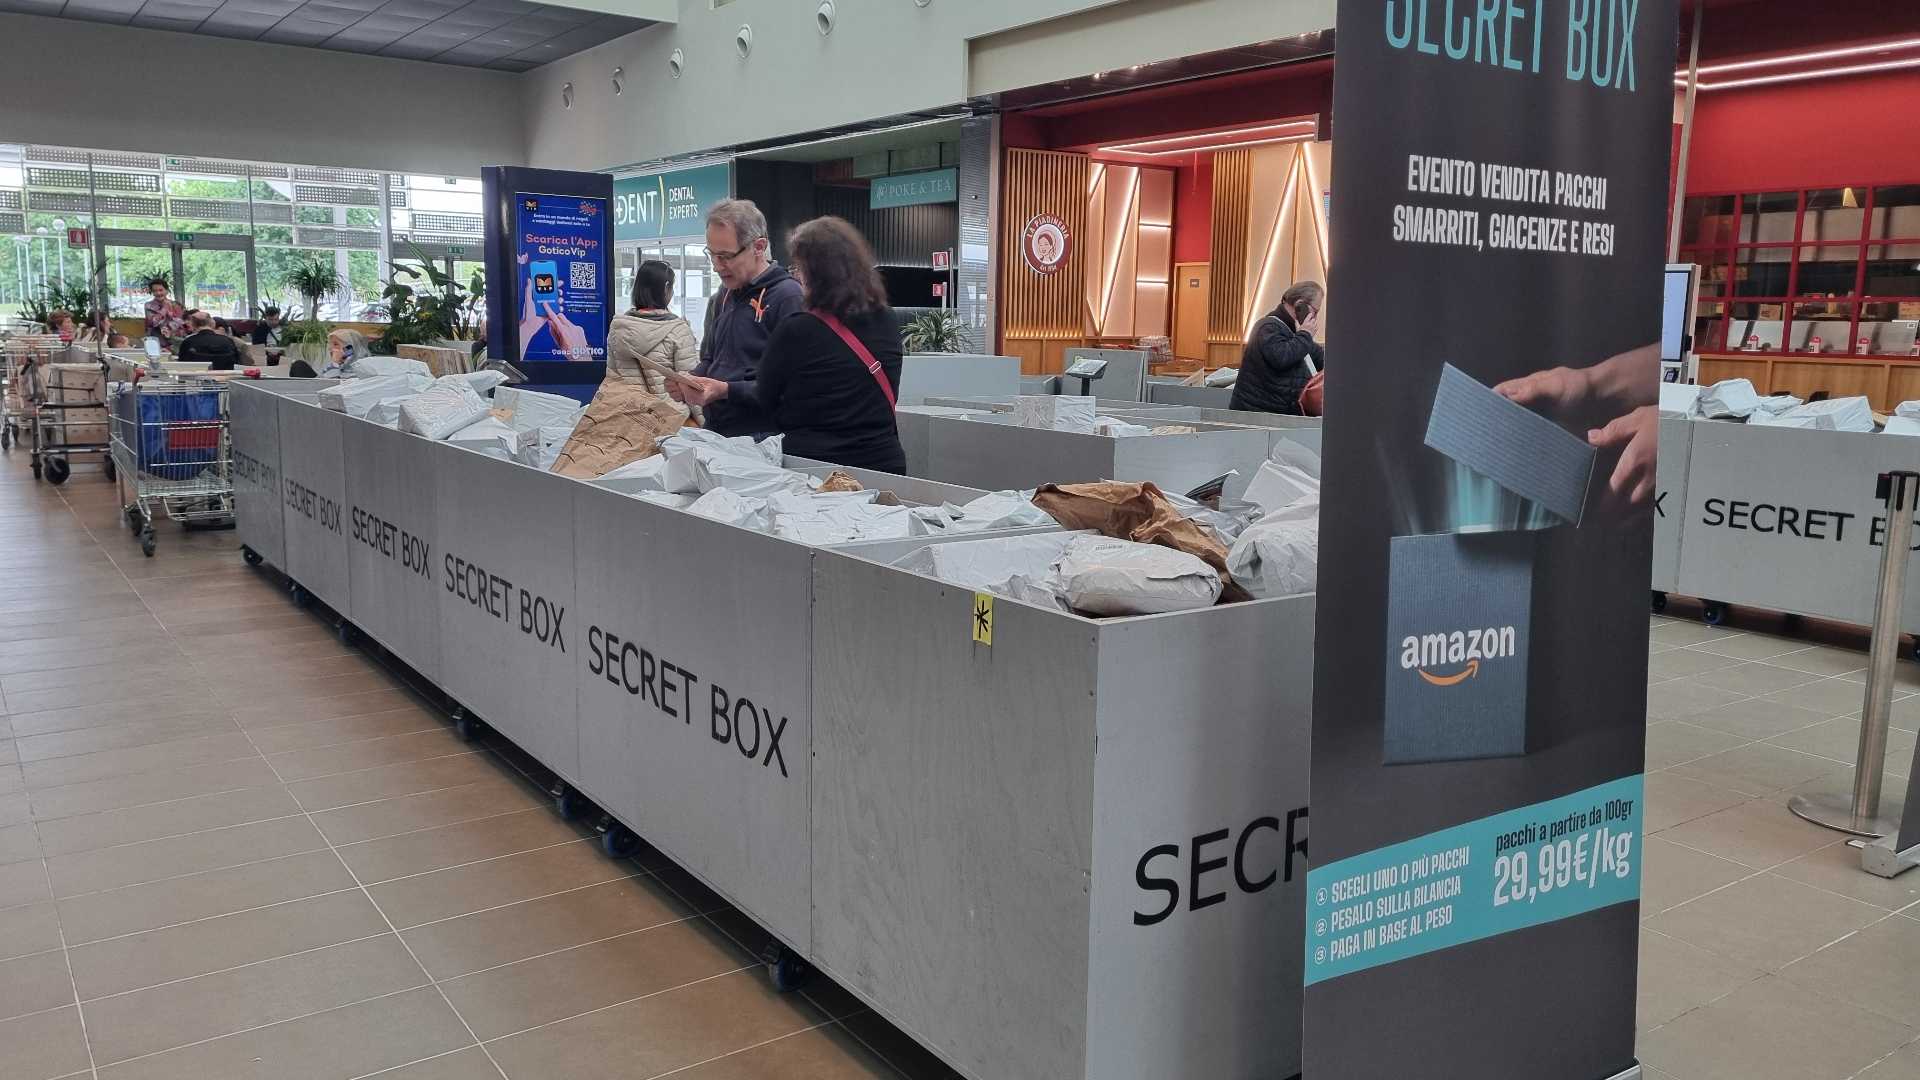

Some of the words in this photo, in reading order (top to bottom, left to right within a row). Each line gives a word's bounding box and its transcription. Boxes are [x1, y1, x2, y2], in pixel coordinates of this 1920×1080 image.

[1566, 0, 1639, 92] BOX
[614, 190, 658, 225] DENT
[669, 185, 695, 202] DENTAL
[888, 182, 917, 198] POKE
[919, 183, 928, 194] &
[928, 175, 952, 193] TEA
[1407, 154, 1476, 197] EVENTO
[1480, 163, 1550, 204] VENDITA
[1554, 171, 1607, 211] PACCHI
[669, 203, 698, 220] EXPERTS
[1034, 215, 1070, 240] PIADINERIA
[1393, 204, 1484, 252] SMARRITI,
[1489, 213, 1568, 252] GIACENZE
[1570, 220, 1579, 253] E
[1582, 222, 1615, 256] RESI
[526, 233, 569, 246] Scarica
[571, 235, 598, 249] l'App
[538, 245, 587, 258] GoticoVip
[285, 478, 317, 521] SECRET
[319, 495, 342, 537] BOX
[1702, 497, 1855, 542] SECRET
[352, 505, 398, 561] SECRET
[401, 531, 431, 580] BOX
[444, 553, 513, 623] SECRET
[520, 588, 567, 653] BOX
[1401, 625, 1516, 669] amazon
[588, 625, 698, 725] SECRET
[711, 683, 788, 778] BOX
[1496, 822, 1537, 858] pacchi
[1539, 824, 1547, 841] a
[1550, 811, 1587, 843] partire
[1589, 805, 1602, 829] da
[1605, 798, 1634, 821] 100gr
[1133, 806, 1309, 927] SECR
[1331, 872, 1371, 904] SCEGLI
[1373, 866, 1398, 891] UNO
[1401, 863, 1409, 884] O
[1411, 855, 1429, 881] PIÙ
[1431, 846, 1470, 874] PACCHI
[1494, 827, 1633, 907] 29,99€/kg
[1331, 901, 1373, 933] PESALO
[1376, 890, 1411, 918] SULLA
[1413, 875, 1461, 908] BILANCIA
[1330, 933, 1361, 962] PAGA
[1363, 928, 1376, 951] IN
[1379, 918, 1408, 945] BASE
[1409, 914, 1423, 937] AL
[1425, 905, 1453, 931] PESO
